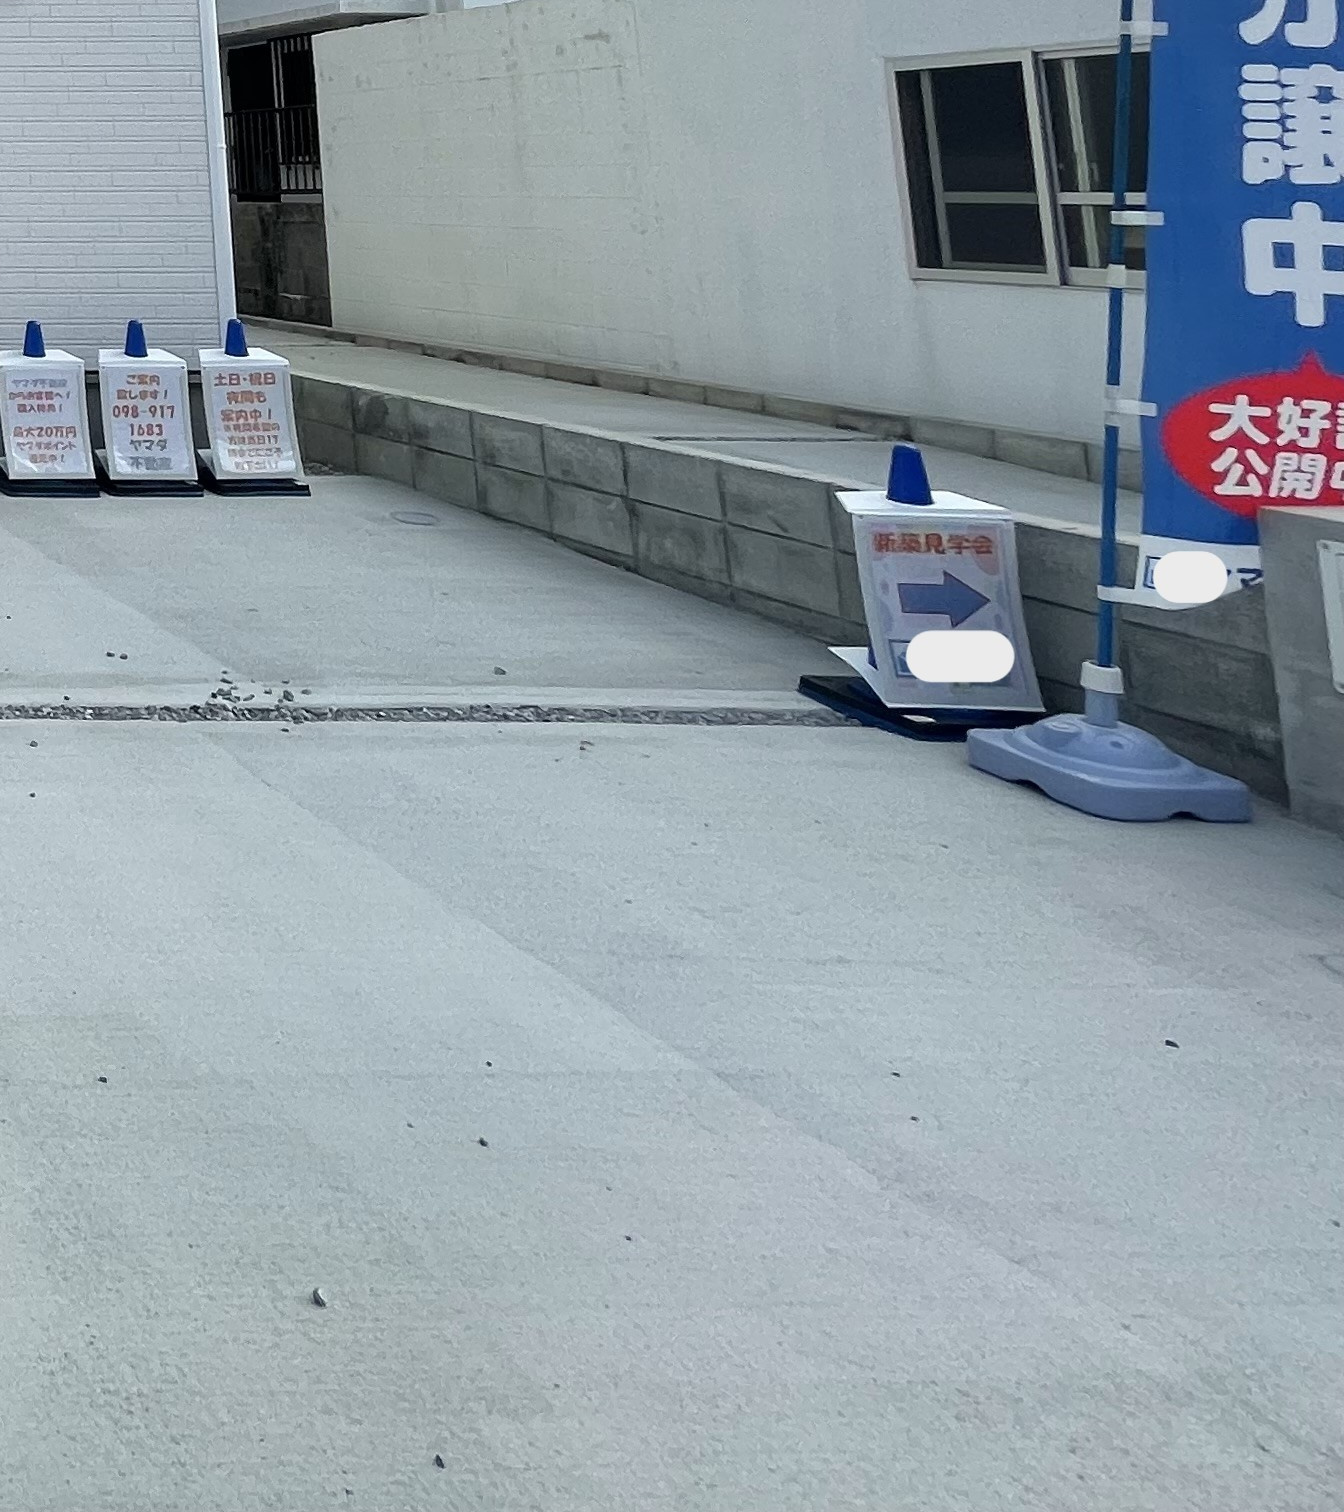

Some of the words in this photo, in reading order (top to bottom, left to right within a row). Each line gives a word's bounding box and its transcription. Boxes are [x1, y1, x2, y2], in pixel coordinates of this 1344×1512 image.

[112, 404, 175, 418] 098-917
[1208, 394, 1344, 449] 大好
[130, 423, 163, 436] 1683
[129, 439, 167, 451] ヤマダ
[873, 532, 994, 555] 新築見学会
